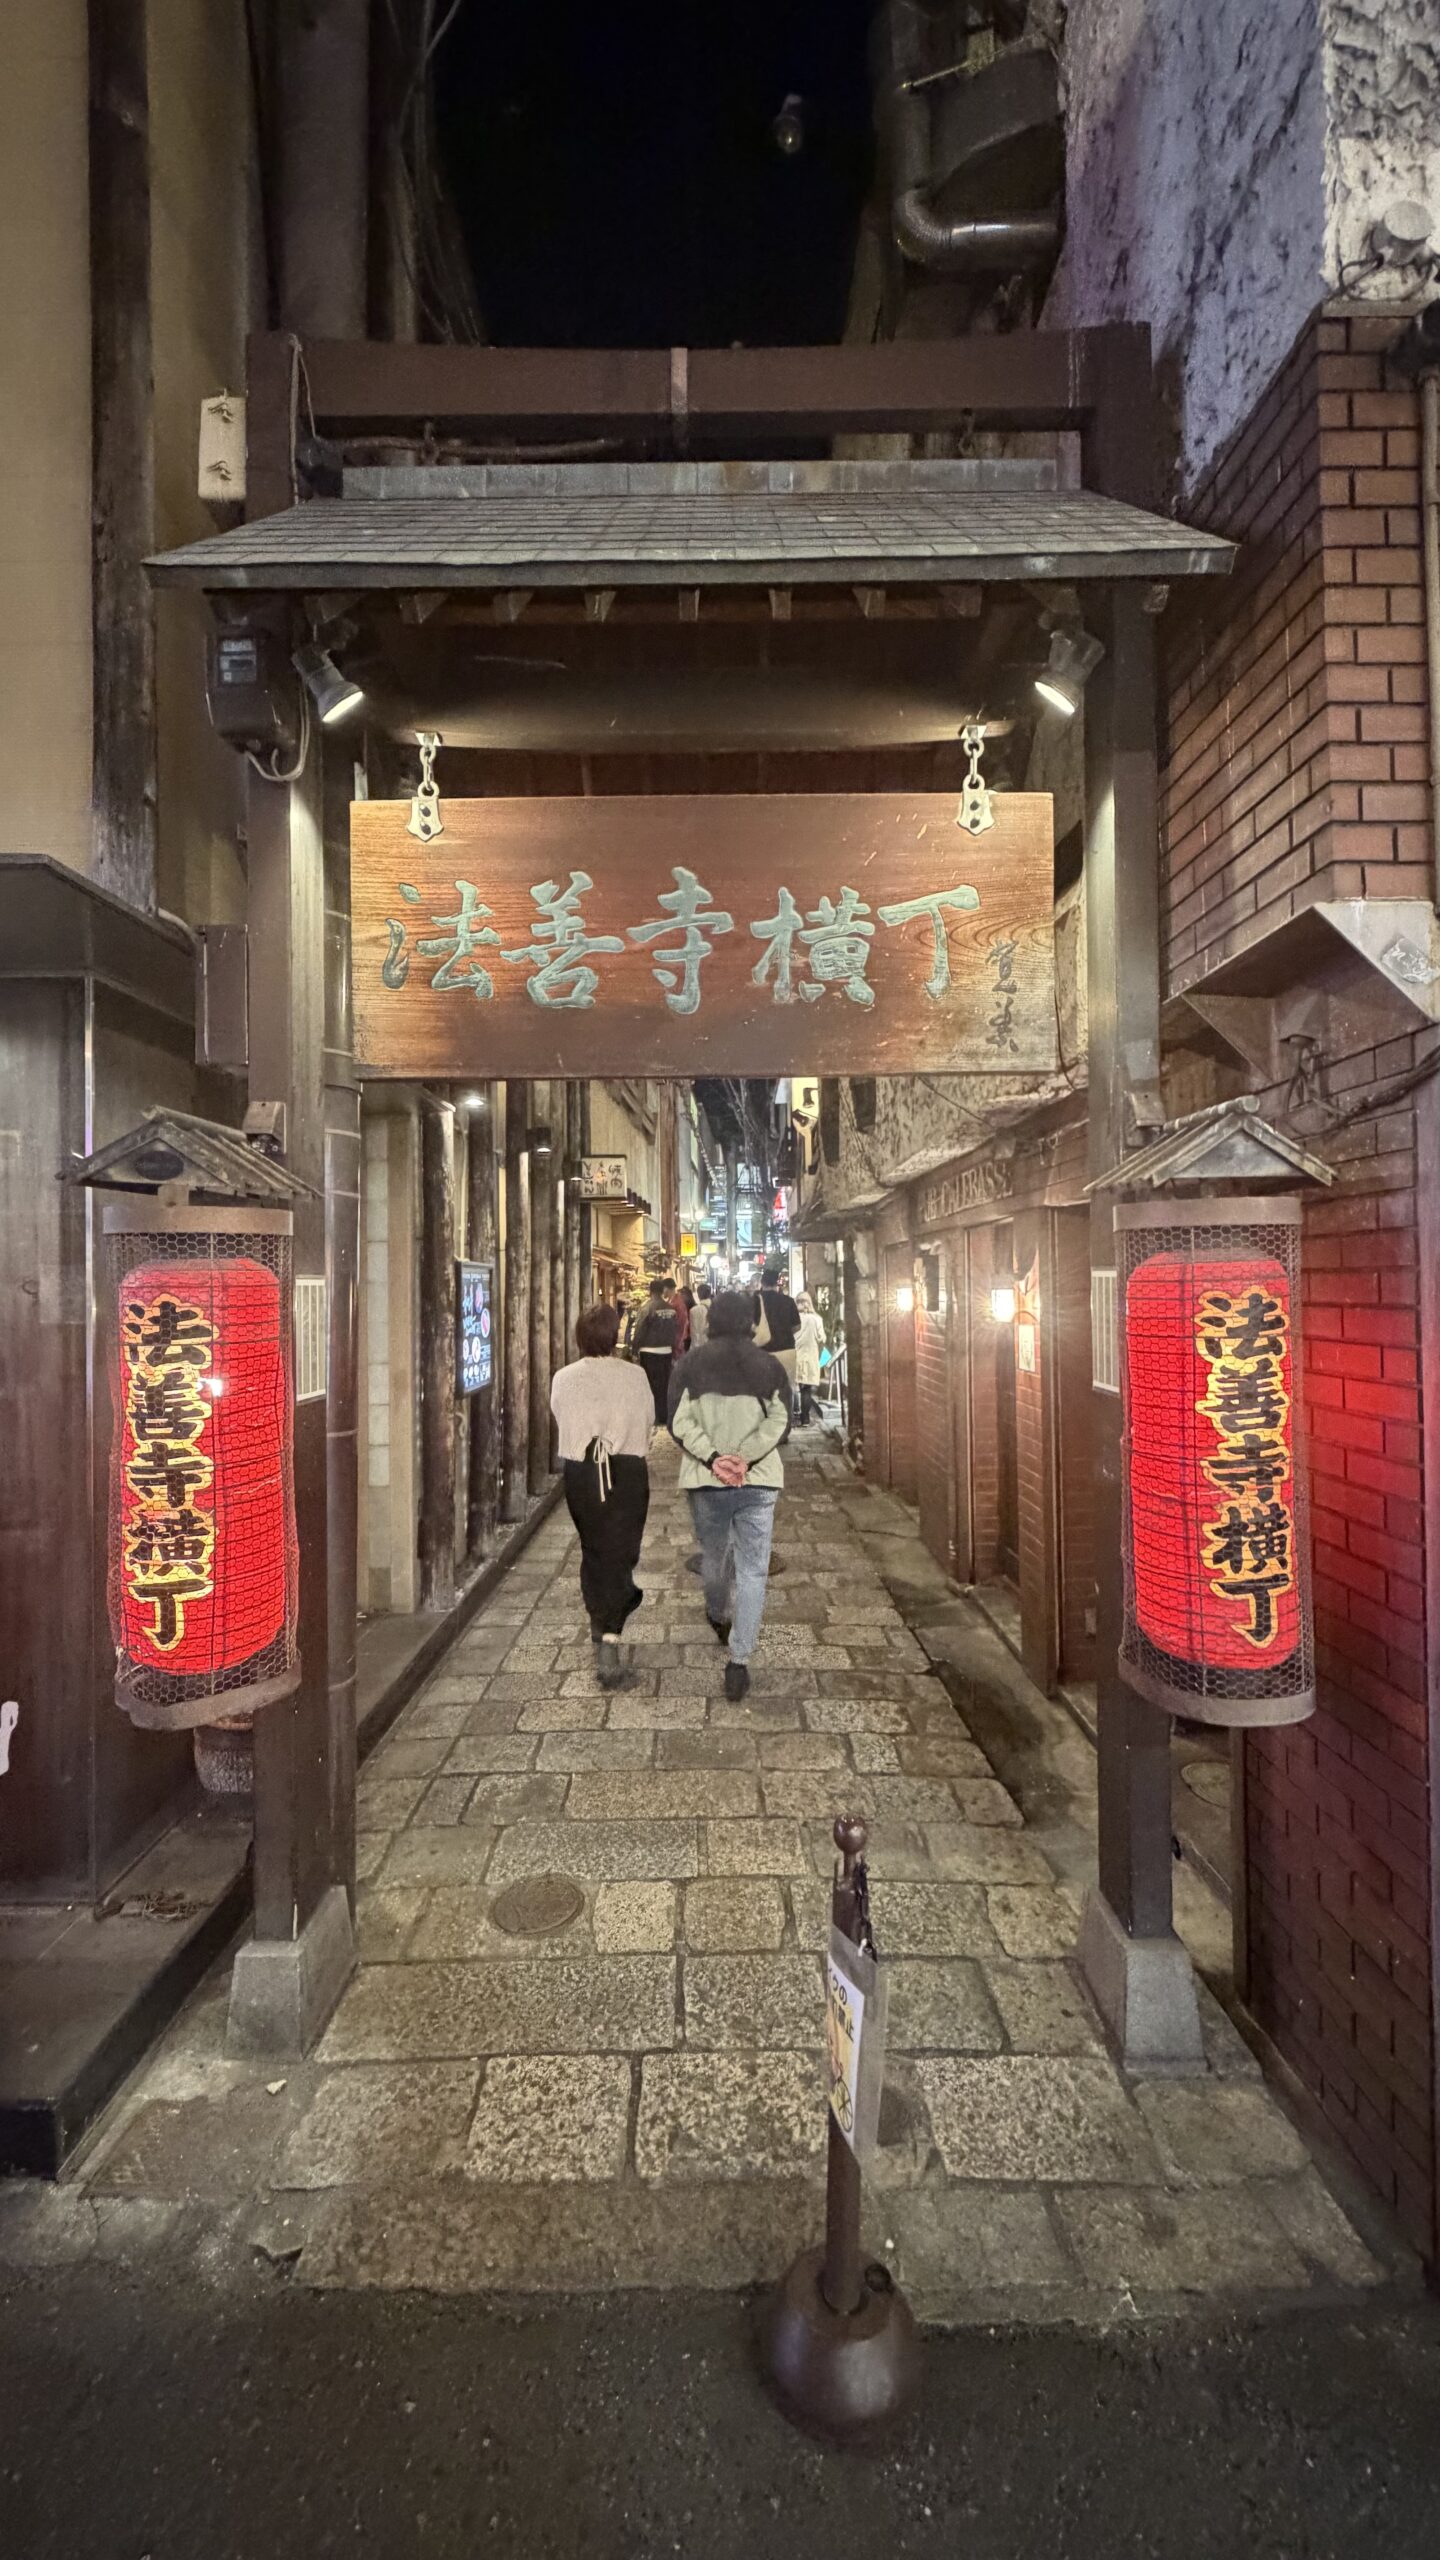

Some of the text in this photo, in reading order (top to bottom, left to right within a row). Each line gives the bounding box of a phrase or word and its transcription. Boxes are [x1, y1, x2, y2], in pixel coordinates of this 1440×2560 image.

[382, 867, 981, 1015] 法善寺横丁
[124, 1294, 218, 1650] 法善寺横丁
[1195, 1287, 1291, 1647] 法善寺横丁
